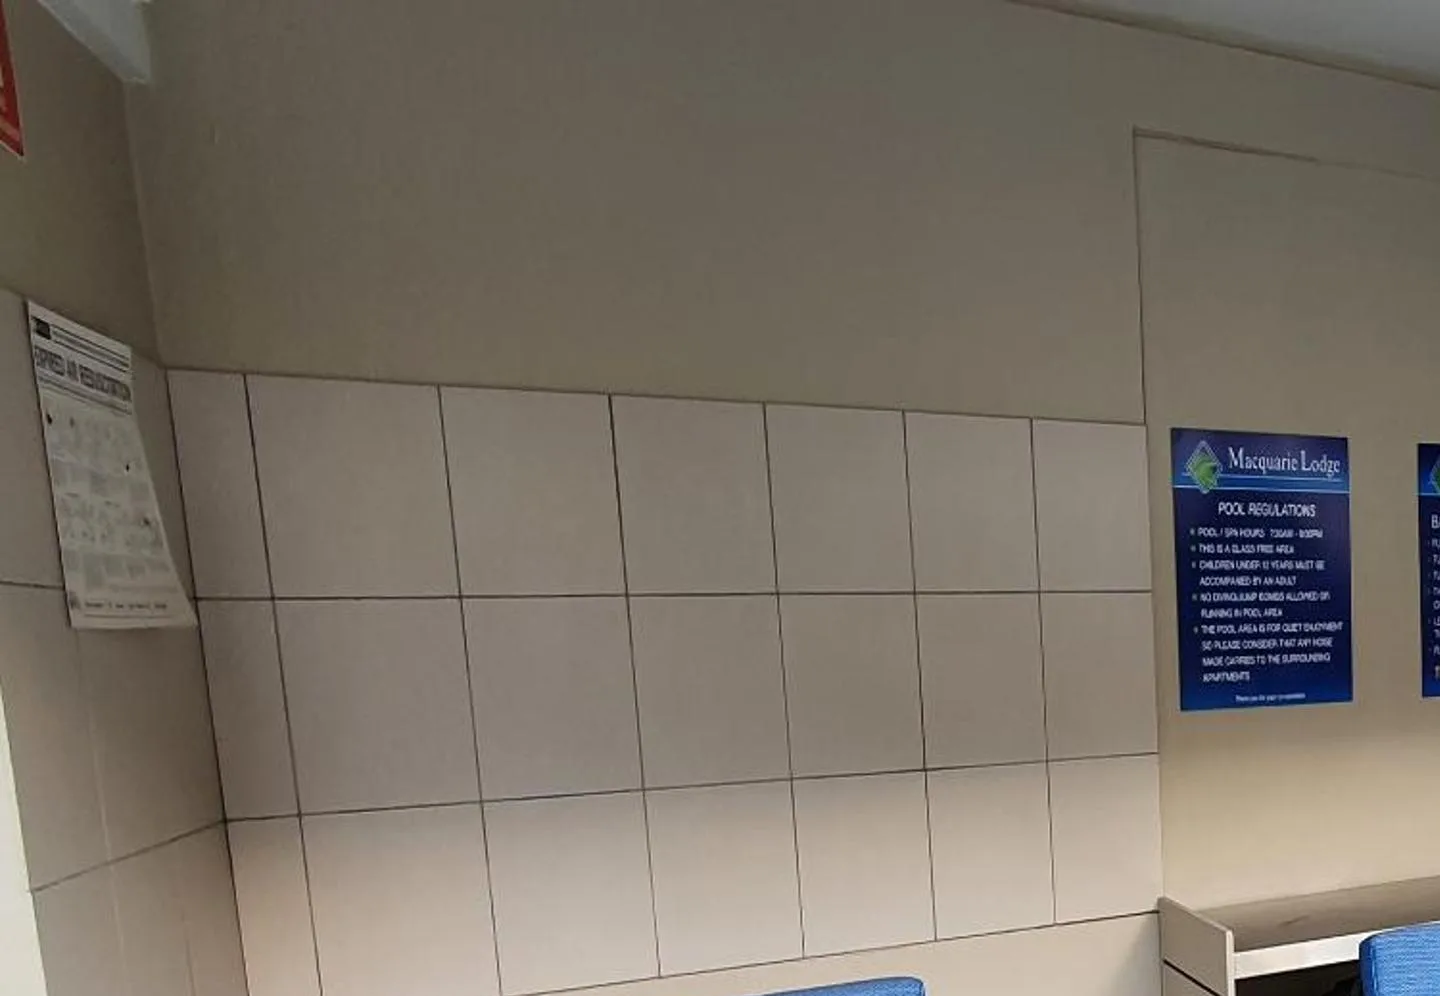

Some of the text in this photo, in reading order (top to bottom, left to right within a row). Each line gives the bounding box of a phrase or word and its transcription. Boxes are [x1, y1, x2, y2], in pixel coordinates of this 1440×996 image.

[1228, 447, 1341, 478] Macquarie Lodge
[1218, 502, 1317, 518] POOL REGULATIONS
[1198, 527, 1218, 537] POOL
[1239, 528, 1266, 538] HOURS
[1199, 544, 1215, 553] THIS
[1199, 560, 1235, 570] CHILDREN
[1236, 560, 1261, 570] UNDER
[1271, 560, 1294, 570] YEARS
[1295, 560, 1314, 570] MUST
[1200, 576, 1251, 586] ACCOMPANIED
[1275, 576, 1297, 586] ADULT
[1243, 608, 1262, 618] POOL
[1201, 624, 1215, 634] THE
[1217, 624, 1236, 634] POOL
[1238, 624, 1257, 634] AREA
[1267, 623, 1280, 632] FOR
[1282, 622, 1302, 632] QUIET
[1303, 621, 1344, 631] ENJOYMENT
[1214, 639, 1240, 650] PLEASE
[1242, 638, 1278, 649] CONSIDER
[1202, 656, 1223, 667] MADE
[1202, 671, 1250, 682] APARTMENTS
